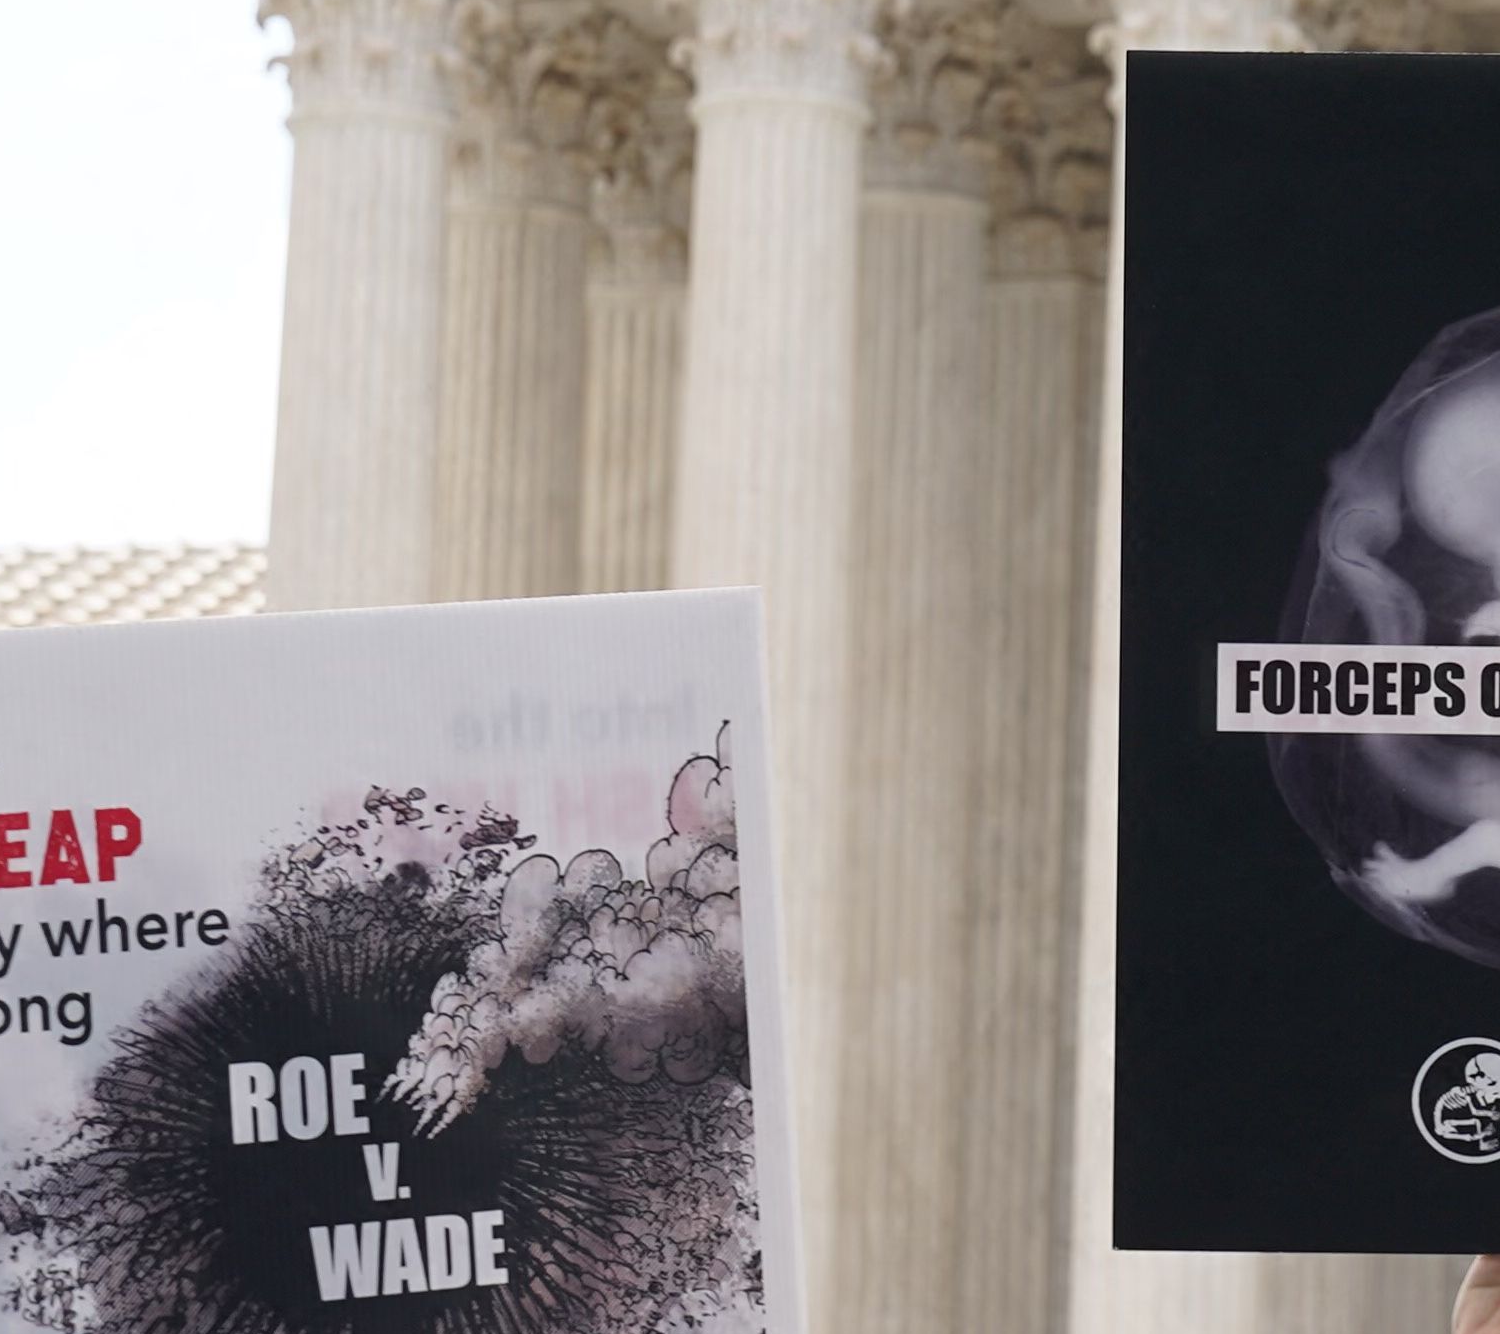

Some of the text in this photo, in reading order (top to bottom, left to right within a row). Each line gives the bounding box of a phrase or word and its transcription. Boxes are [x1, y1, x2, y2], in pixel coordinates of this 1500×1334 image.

[1235, 660, 1466, 718] FORCEPS
[41, 898, 229, 957] where
[228, 1053, 370, 1144] ROE
[362, 1142, 411, 1201] V.
[309, 1209, 509, 1301] WADE
